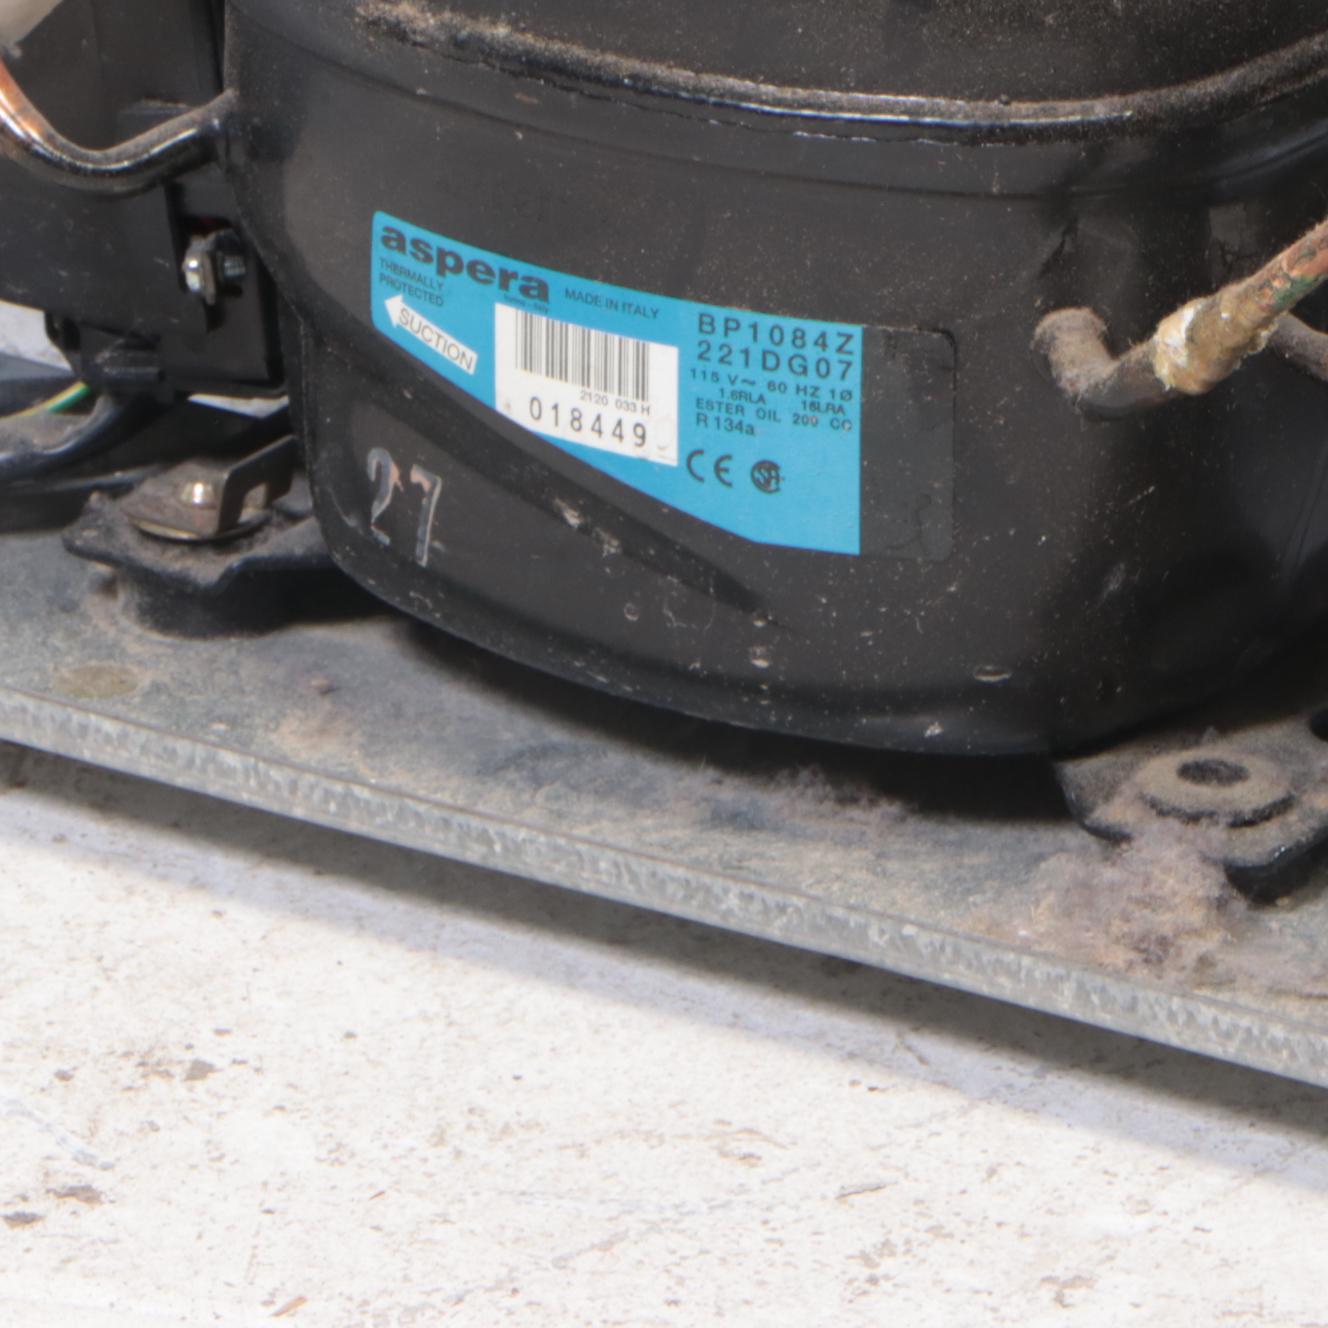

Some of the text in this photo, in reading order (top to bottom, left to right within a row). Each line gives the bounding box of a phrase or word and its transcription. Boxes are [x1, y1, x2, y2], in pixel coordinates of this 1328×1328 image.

[379, 257, 444, 291] THERMALLY
[381, 225, 549, 304] aspera
[379, 272, 444, 307] PROTECTED
[564, 287, 602, 309] MADE
[605, 299, 619, 313] IN
[622, 301, 660, 320] ITALY
[398, 307, 473, 371] SUCTION
[698, 313, 854, 355] BP1084Z
[697, 339, 853, 381] 221DG07
[580, 389, 609, 407] 2120
[796, 384, 820, 398] HZ
[529, 396, 647, 448] 018449
[696, 397, 745, 416] ESTER
[755, 407, 781, 422] OIL
[714, 416, 755, 436] 134a
[686, 449, 733, 487] CE
[366, 446, 442, 568] 27
